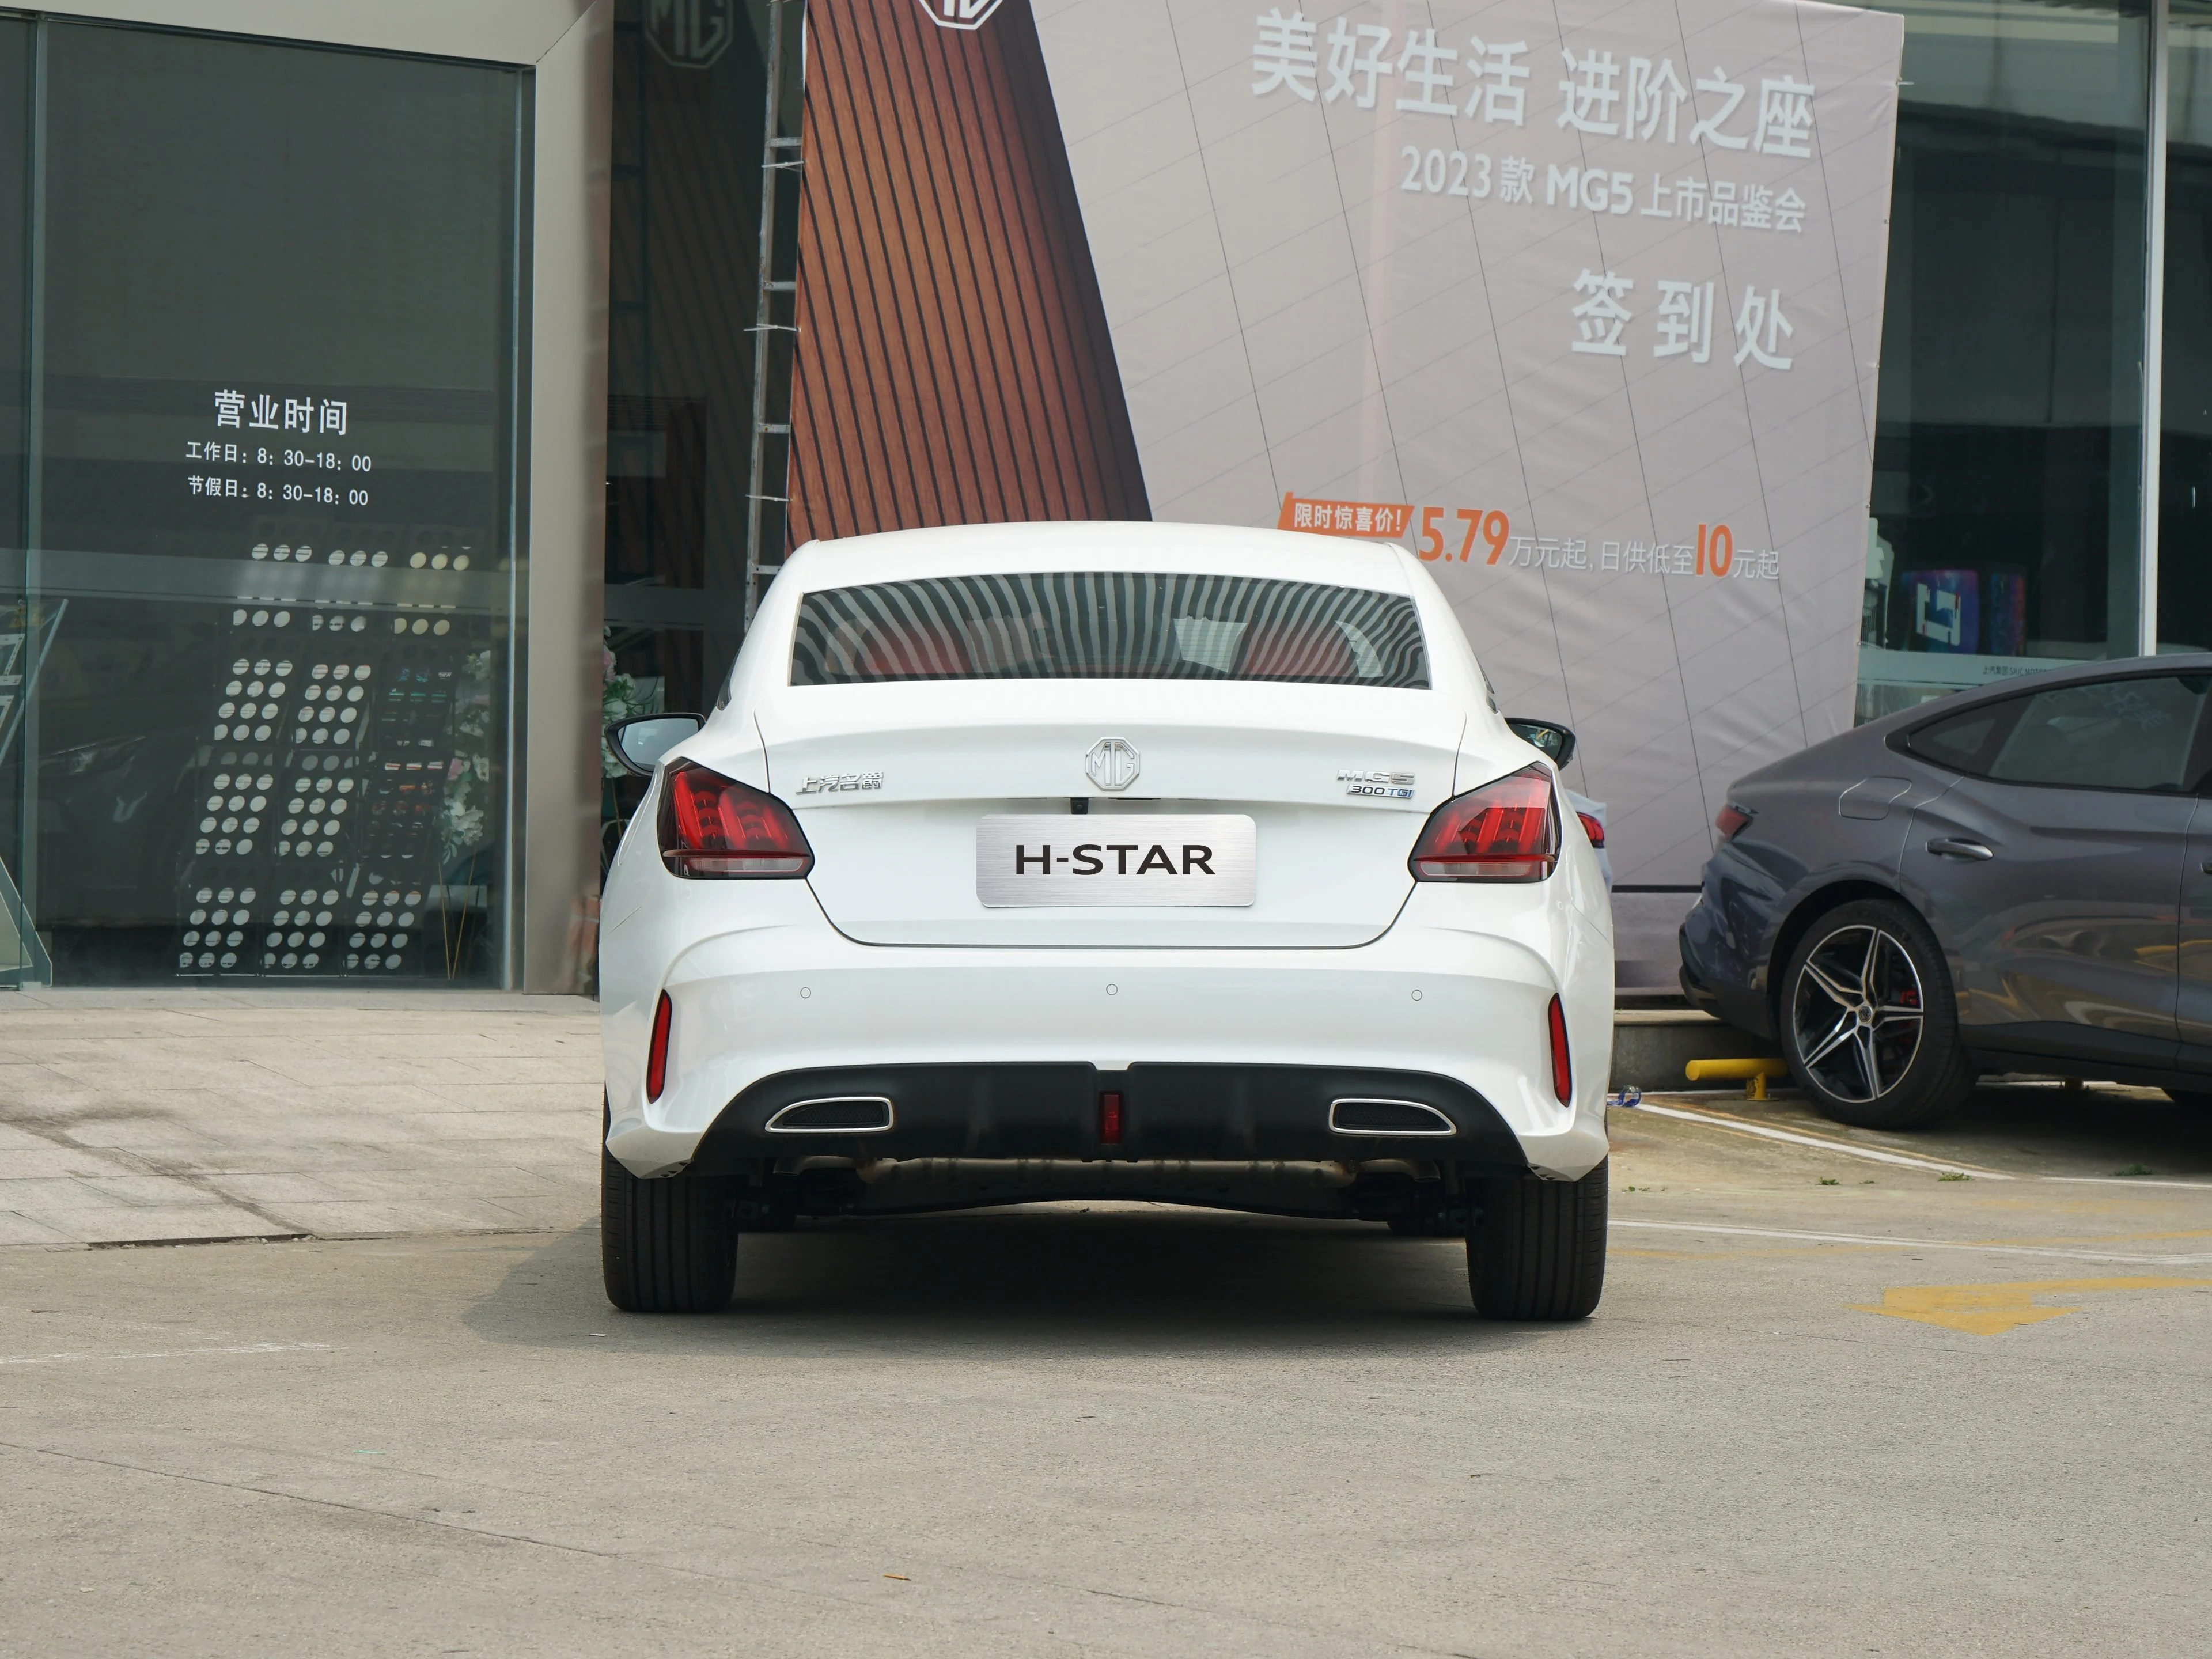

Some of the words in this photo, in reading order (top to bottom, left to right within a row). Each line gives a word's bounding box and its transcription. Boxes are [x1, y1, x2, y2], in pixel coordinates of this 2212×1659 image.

[1251, 7, 1530, 126] 美好生活
[1556, 48, 1815, 158] 进阶之座
[1571, 268, 1793, 369] 签到处
[215, 389, 347, 435] 营业时间
[796, 772, 884, 795] 上汽名爵
[1090, 741, 1135, 786] MG
[1337, 769, 1415, 785] MG5
[1016, 844, 1216, 875] H-STAR
